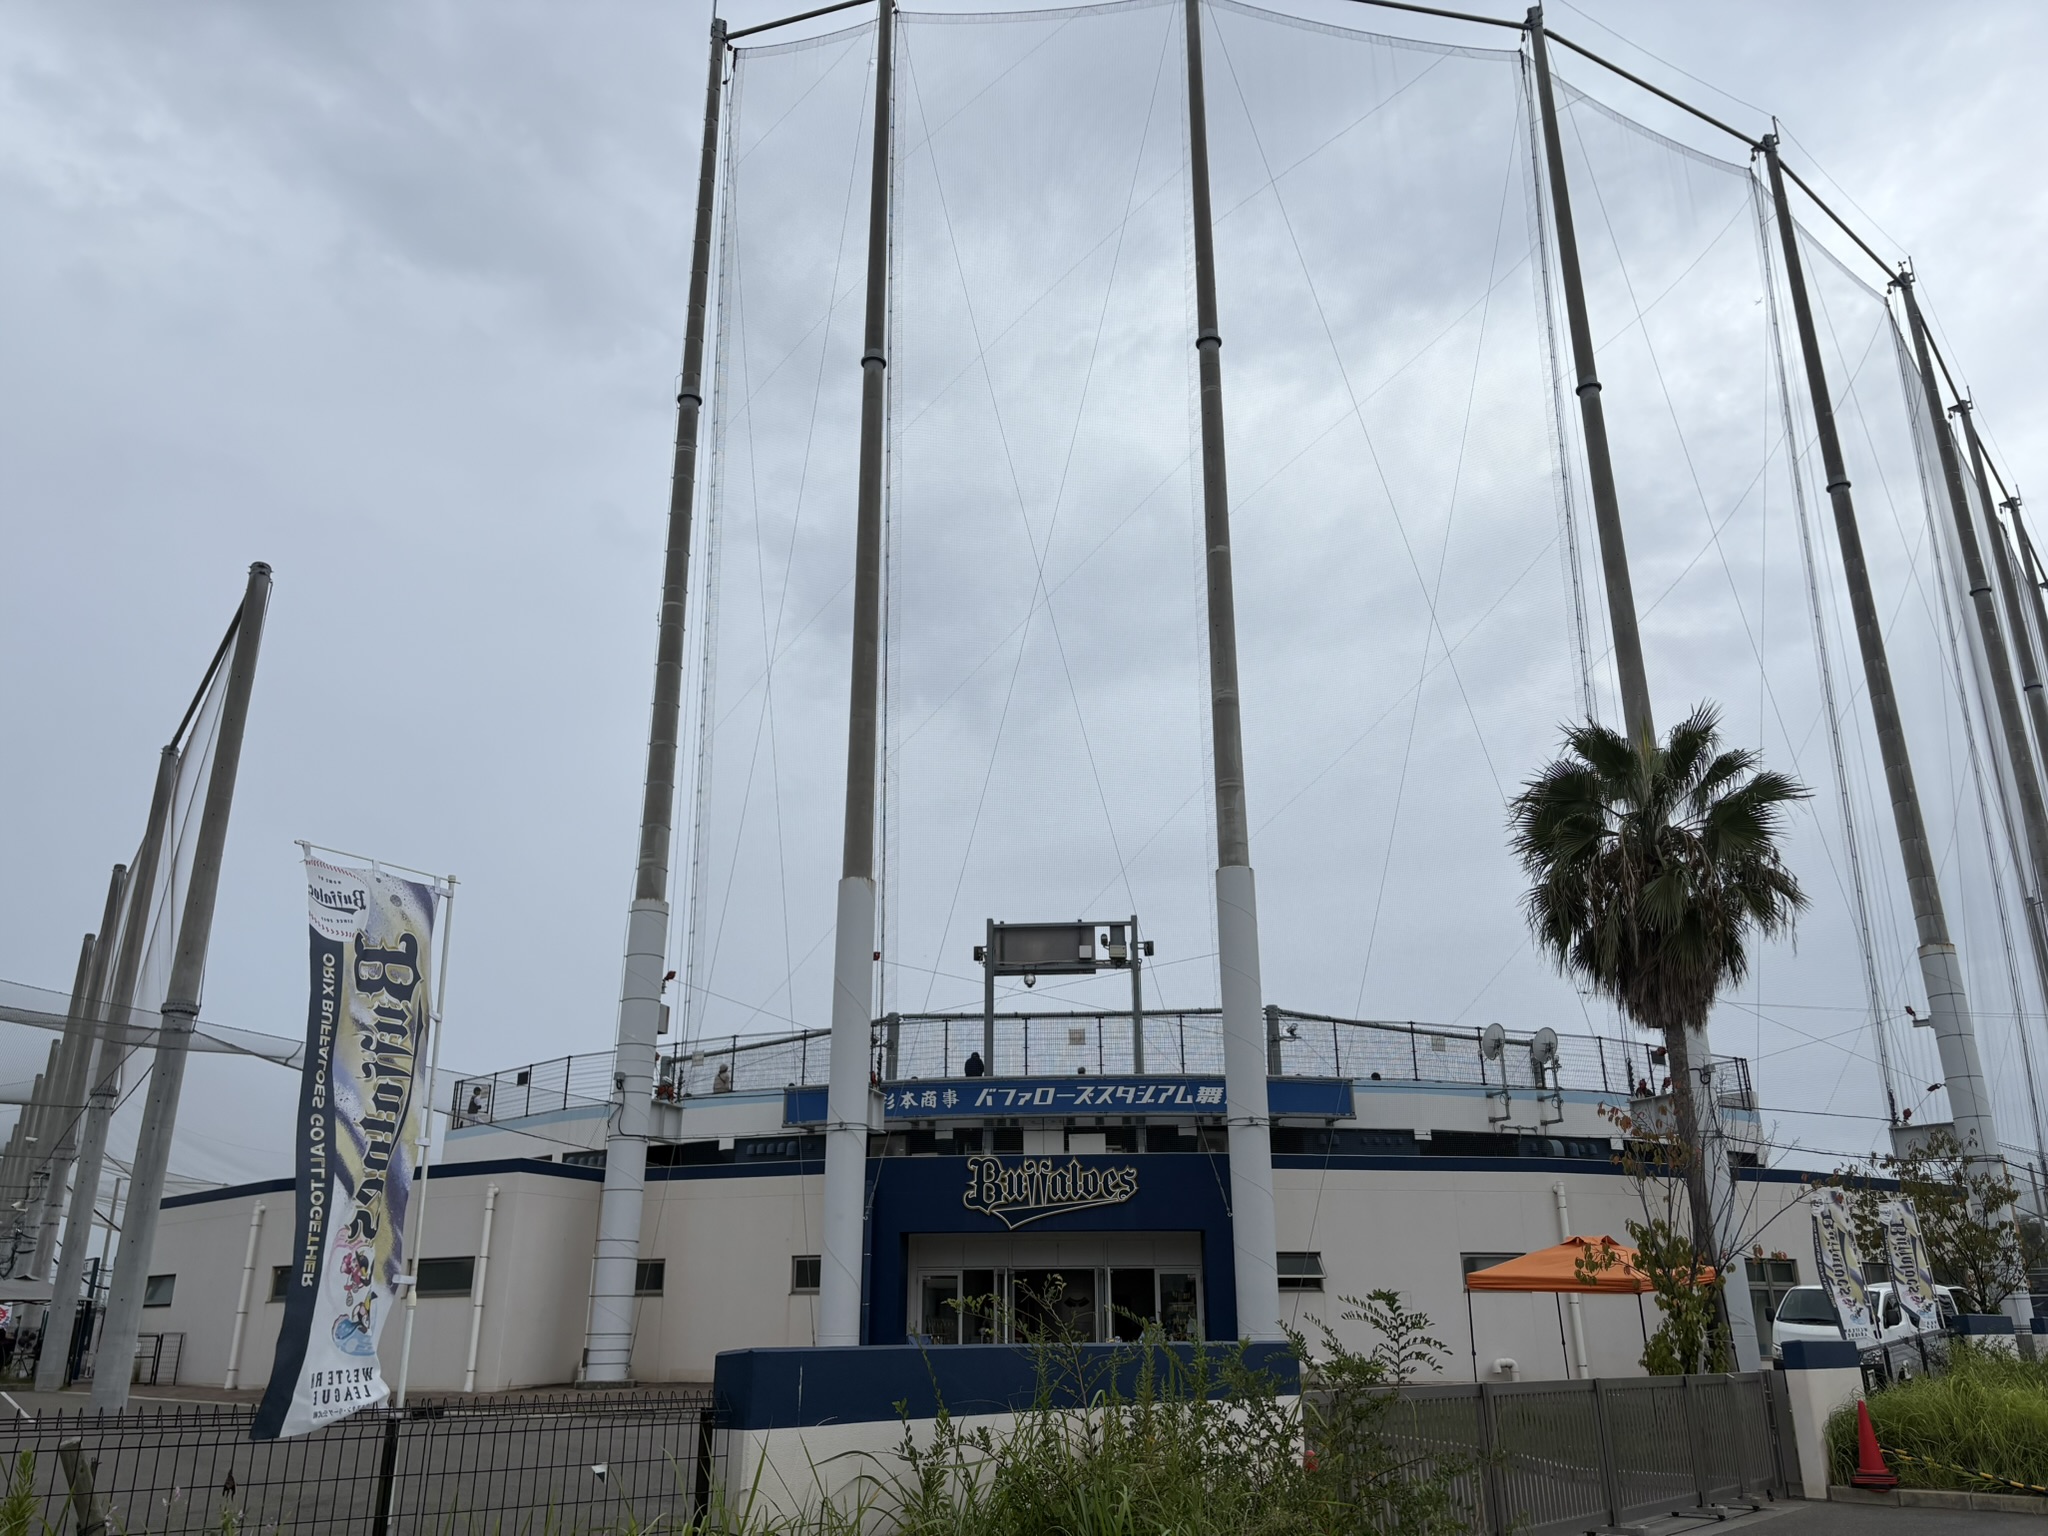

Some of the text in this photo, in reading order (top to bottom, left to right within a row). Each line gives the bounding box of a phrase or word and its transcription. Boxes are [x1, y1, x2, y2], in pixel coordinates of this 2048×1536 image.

[974, 1085, 1226, 1107] バファローズスタジアム舞
[962, 1155, 1138, 1219] Buffaloes
